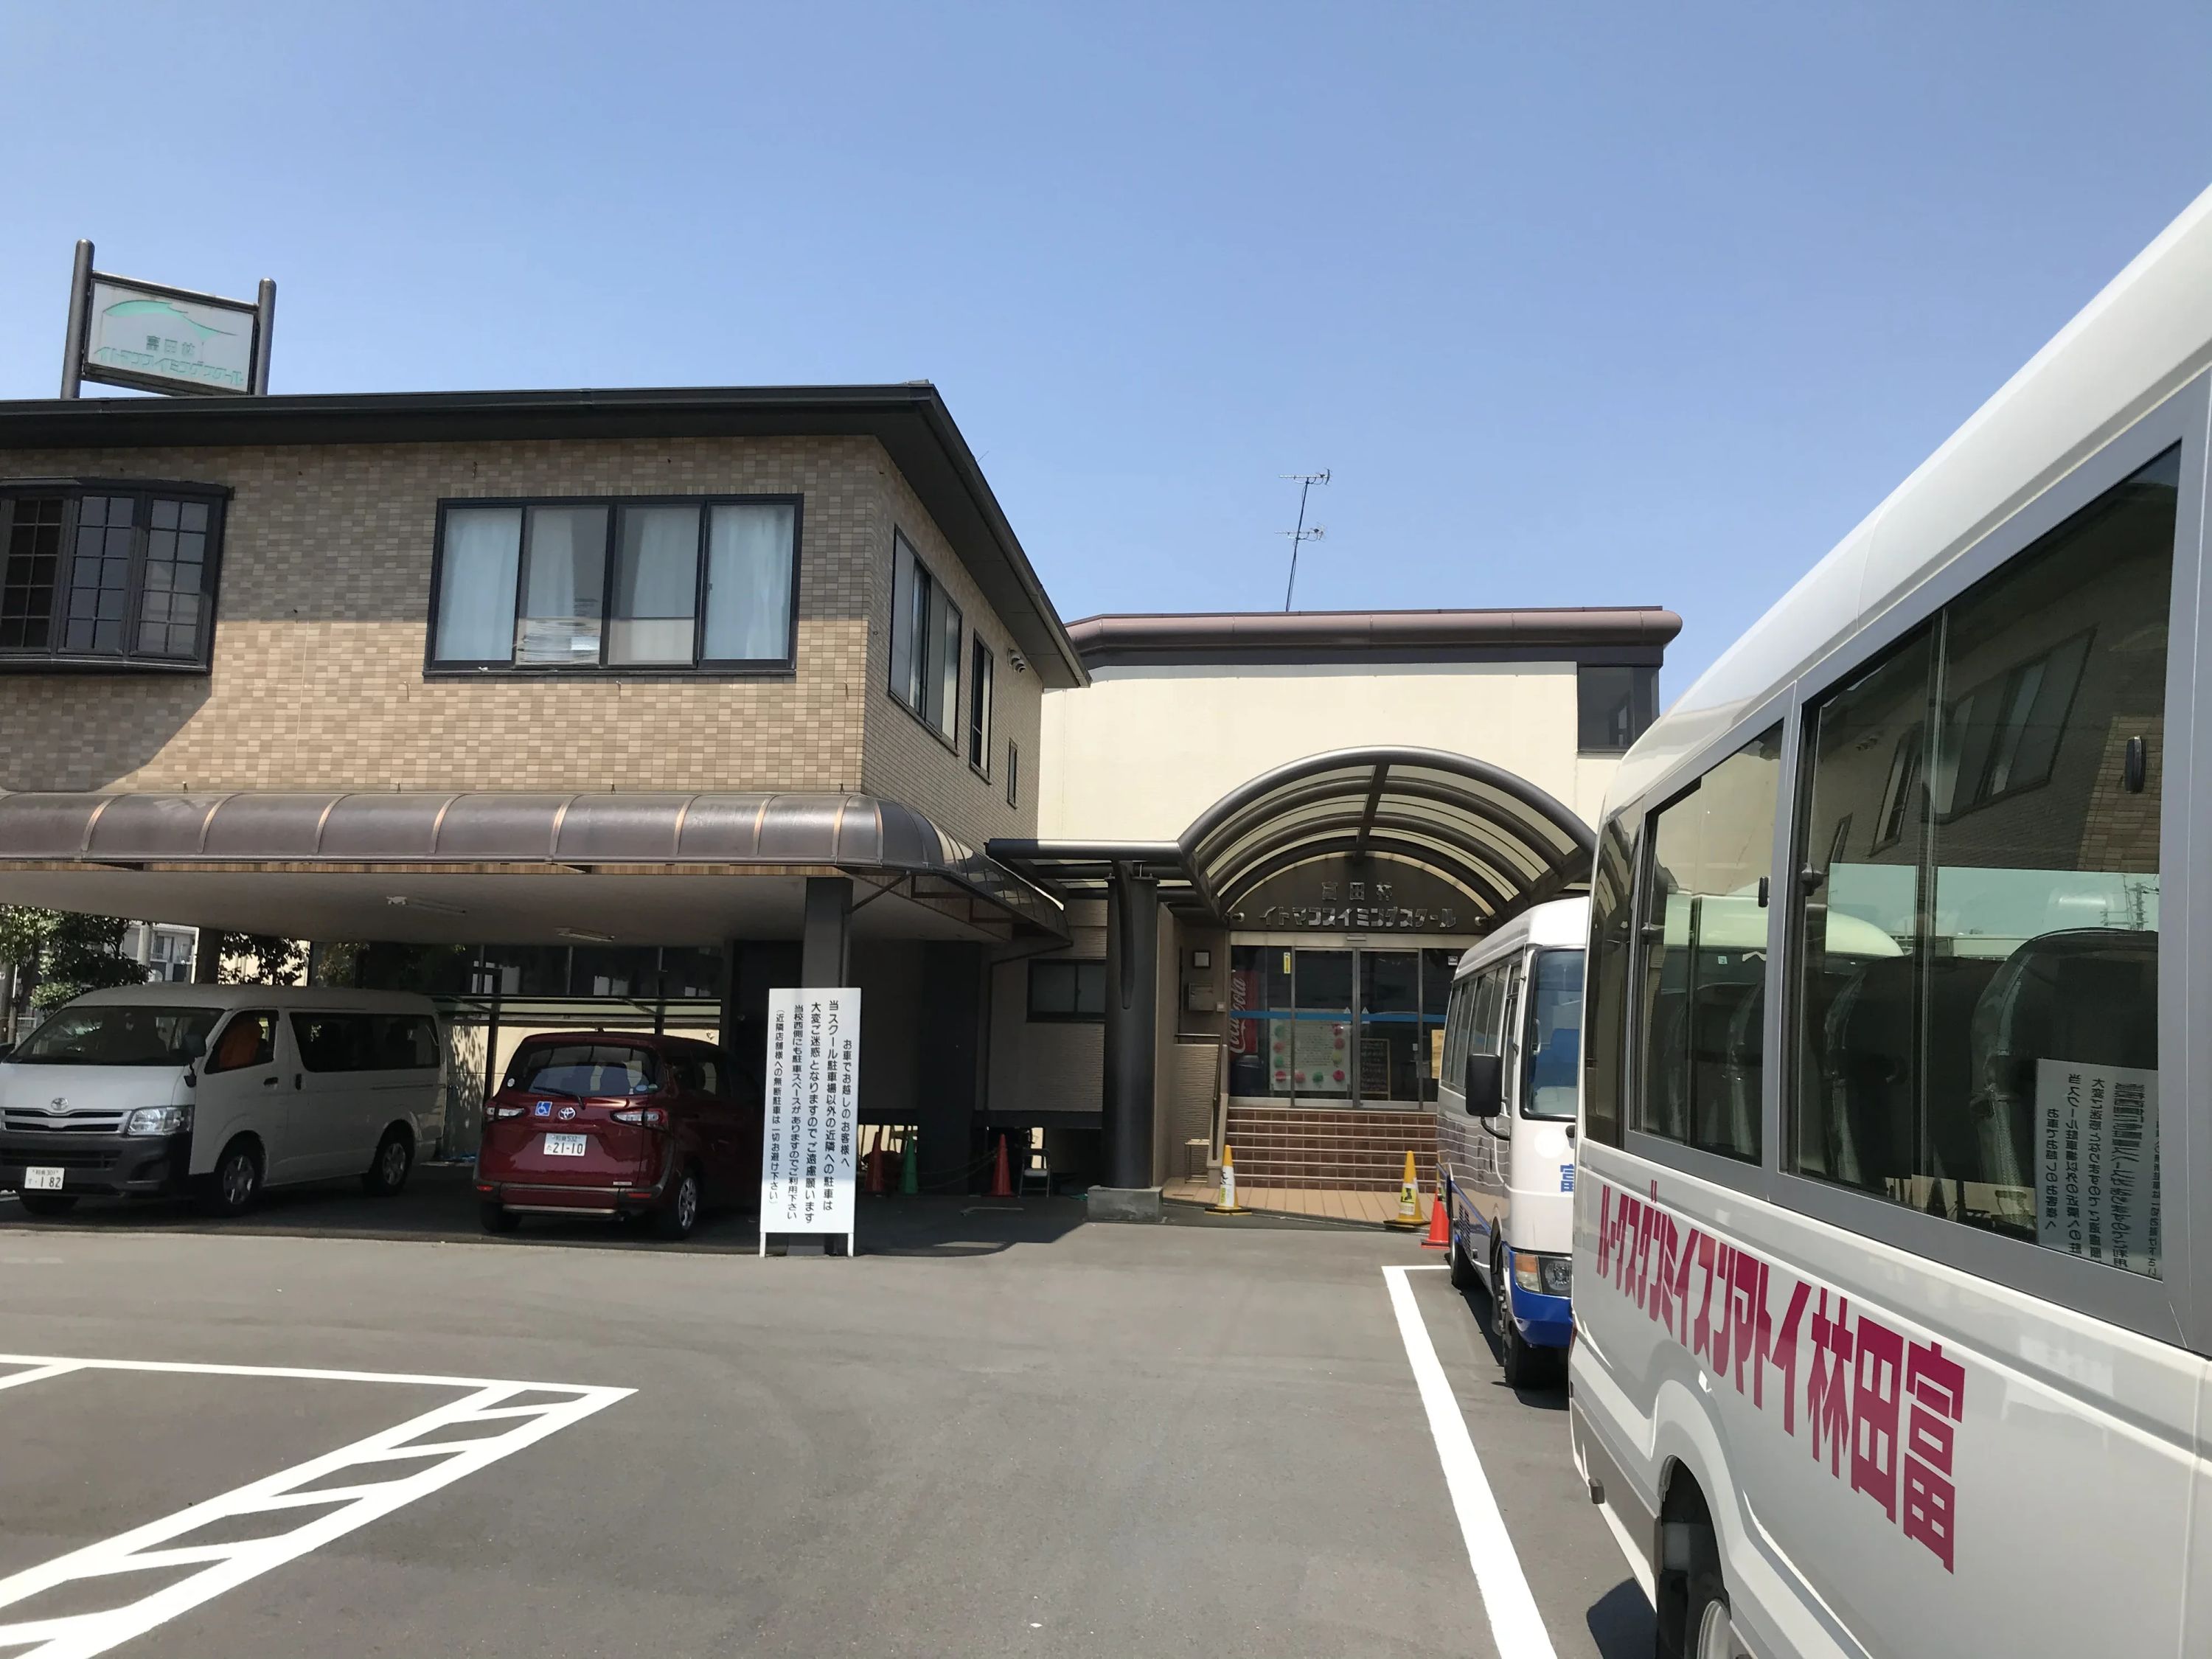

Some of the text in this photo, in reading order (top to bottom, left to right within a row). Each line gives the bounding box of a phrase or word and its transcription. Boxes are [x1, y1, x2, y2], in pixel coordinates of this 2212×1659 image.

[1259, 906, 1457, 928] イトマンスイミングスクール
[553, 1142, 583, 1154] 21-10
[1559, 1164, 1574, 1192] 富
